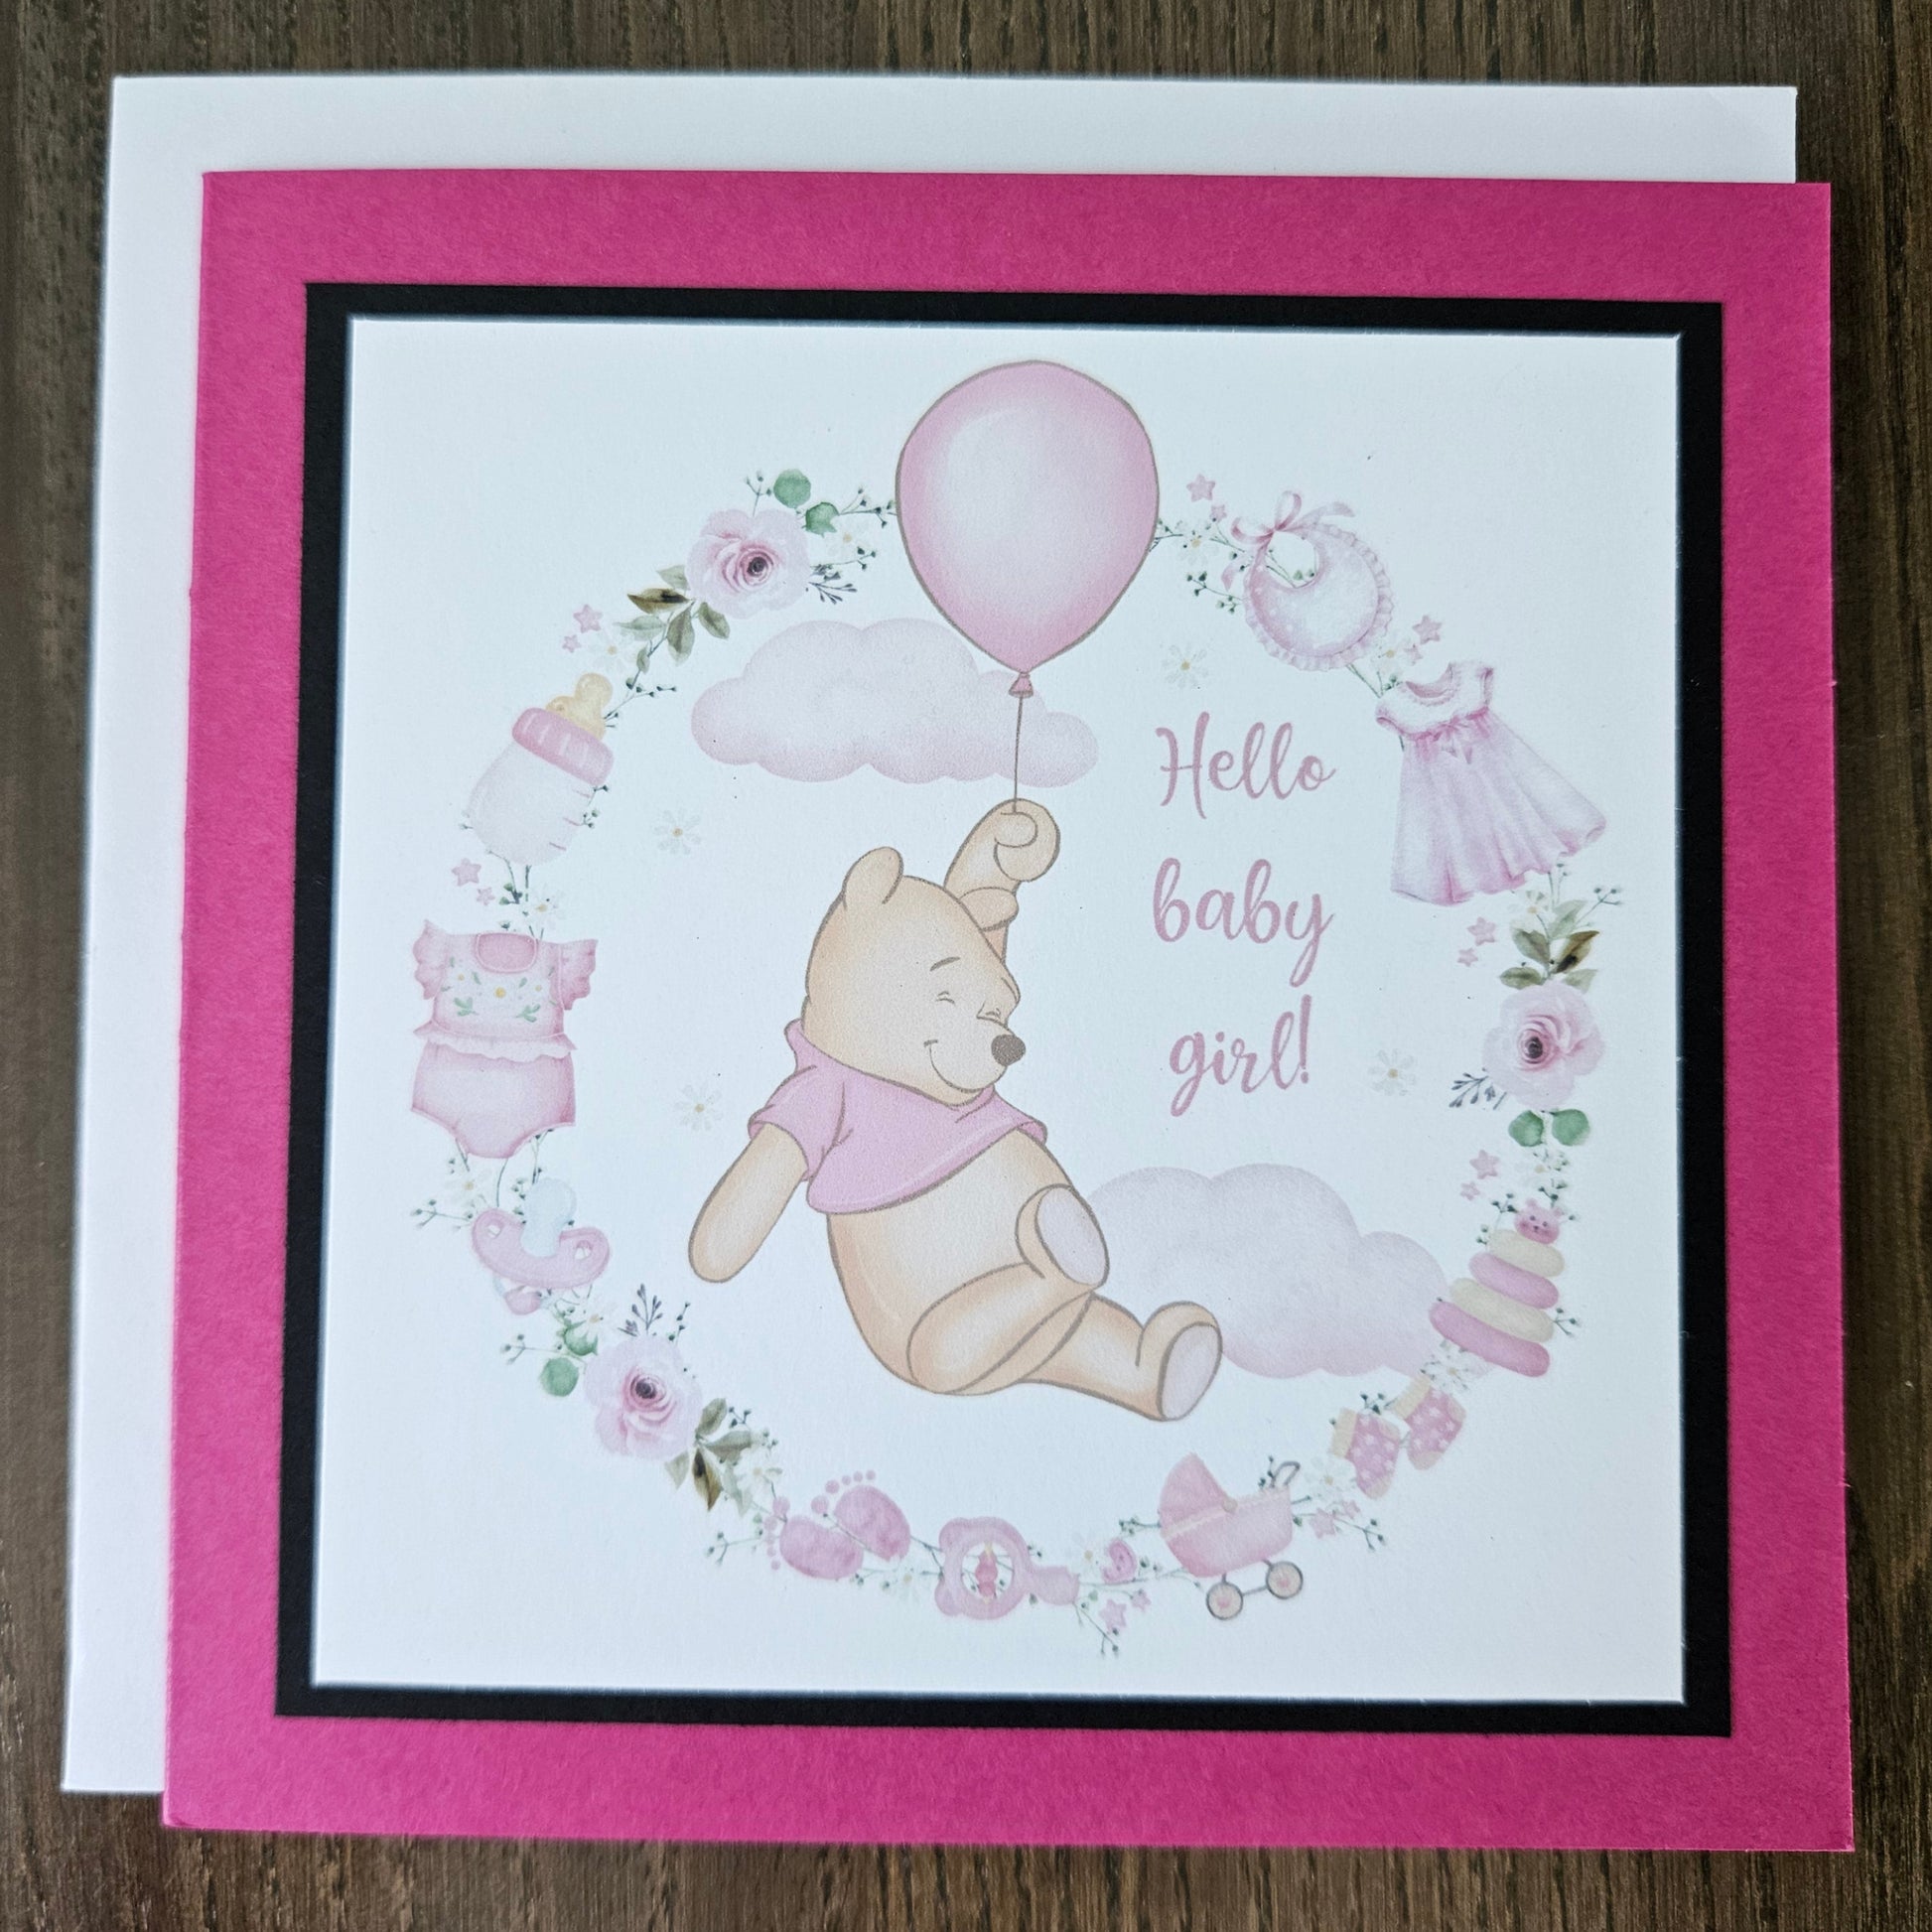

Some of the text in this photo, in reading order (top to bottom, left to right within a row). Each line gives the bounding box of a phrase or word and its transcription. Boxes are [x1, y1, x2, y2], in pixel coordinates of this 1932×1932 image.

[1156, 711, 1336, 819] Hello
[1153, 857, 1335, 988] baby
[1170, 994, 1312, 1117] girl!
